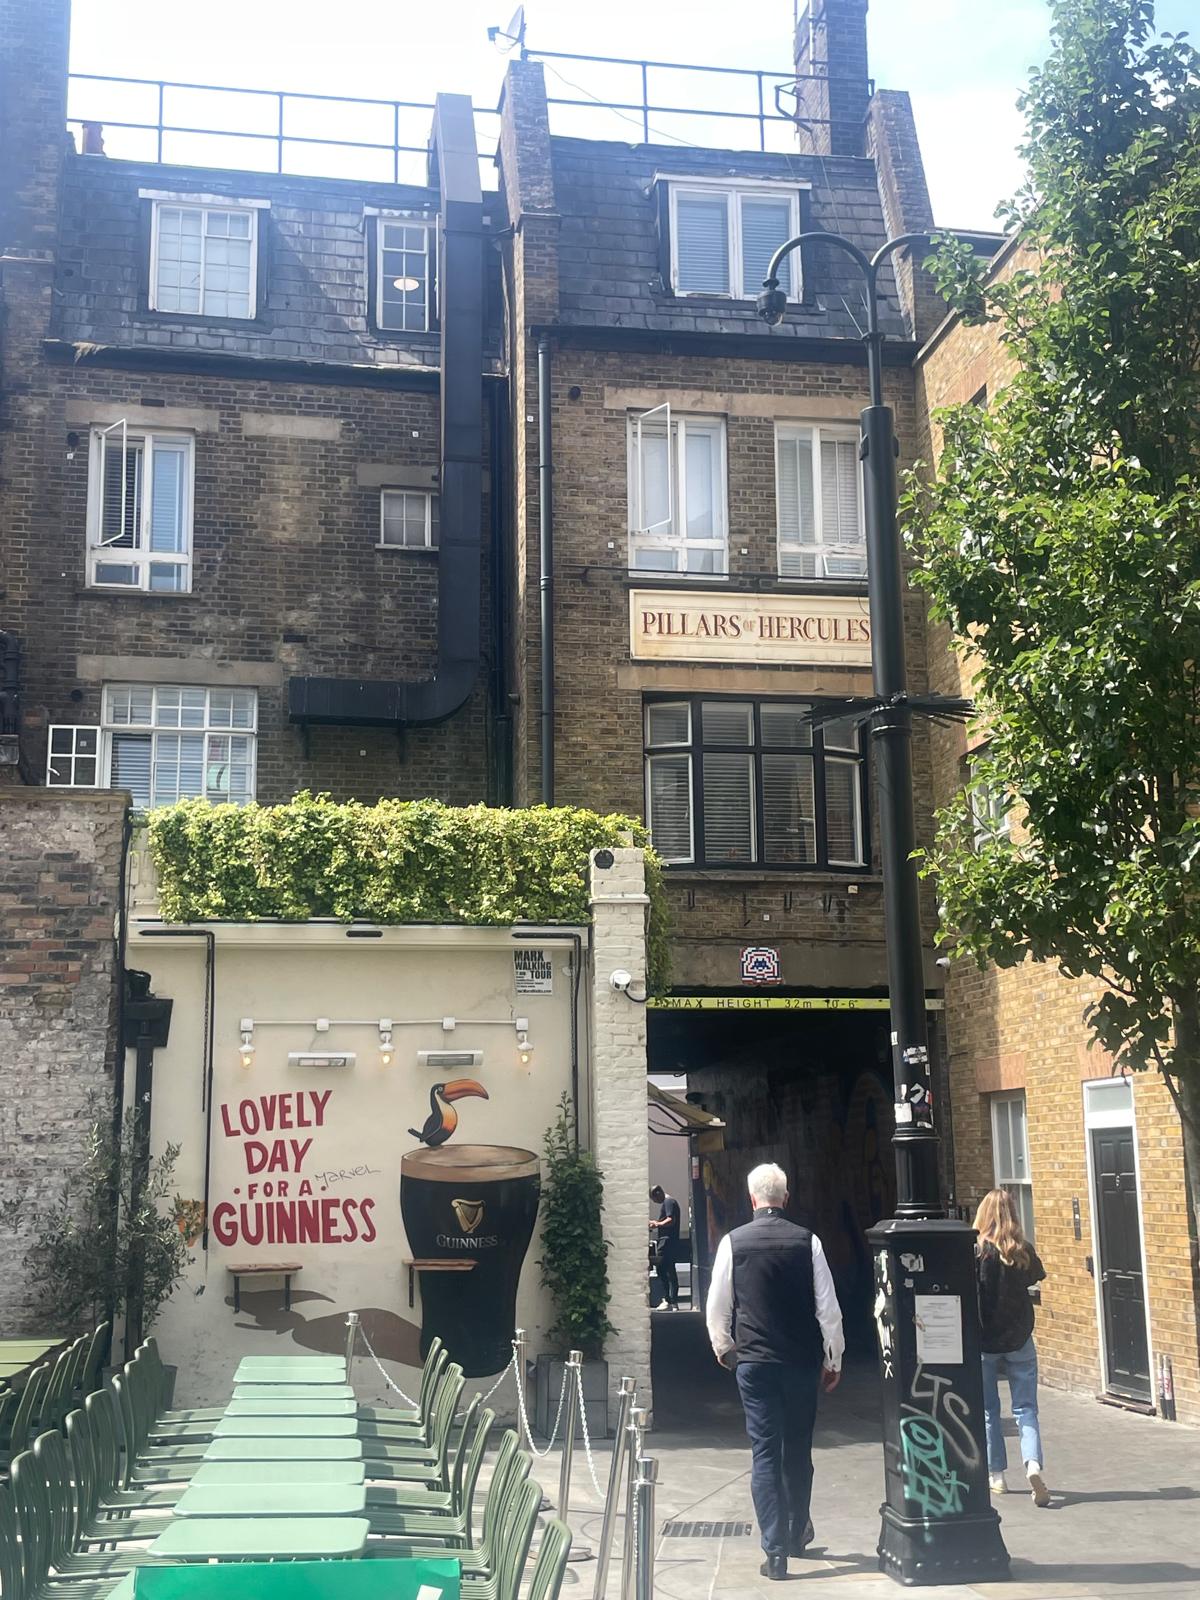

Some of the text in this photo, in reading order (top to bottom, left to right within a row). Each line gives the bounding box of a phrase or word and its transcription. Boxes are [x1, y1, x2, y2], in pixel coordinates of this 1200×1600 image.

[641, 611, 742, 638] PILLARS
[758, 615, 870, 642] HERCULES
[515, 961, 552, 971] WALKING
[529, 971, 552, 980] TOUR
[672, 998, 704, 1008] MAX
[716, 998, 772, 1008] HEIGHT
[220, 1089, 333, 1137] LOVELY
[244, 1138, 313, 1174] DAY
[248, 1180, 313, 1200] FOR A
[212, 1198, 376, 1246] GUINNESS
